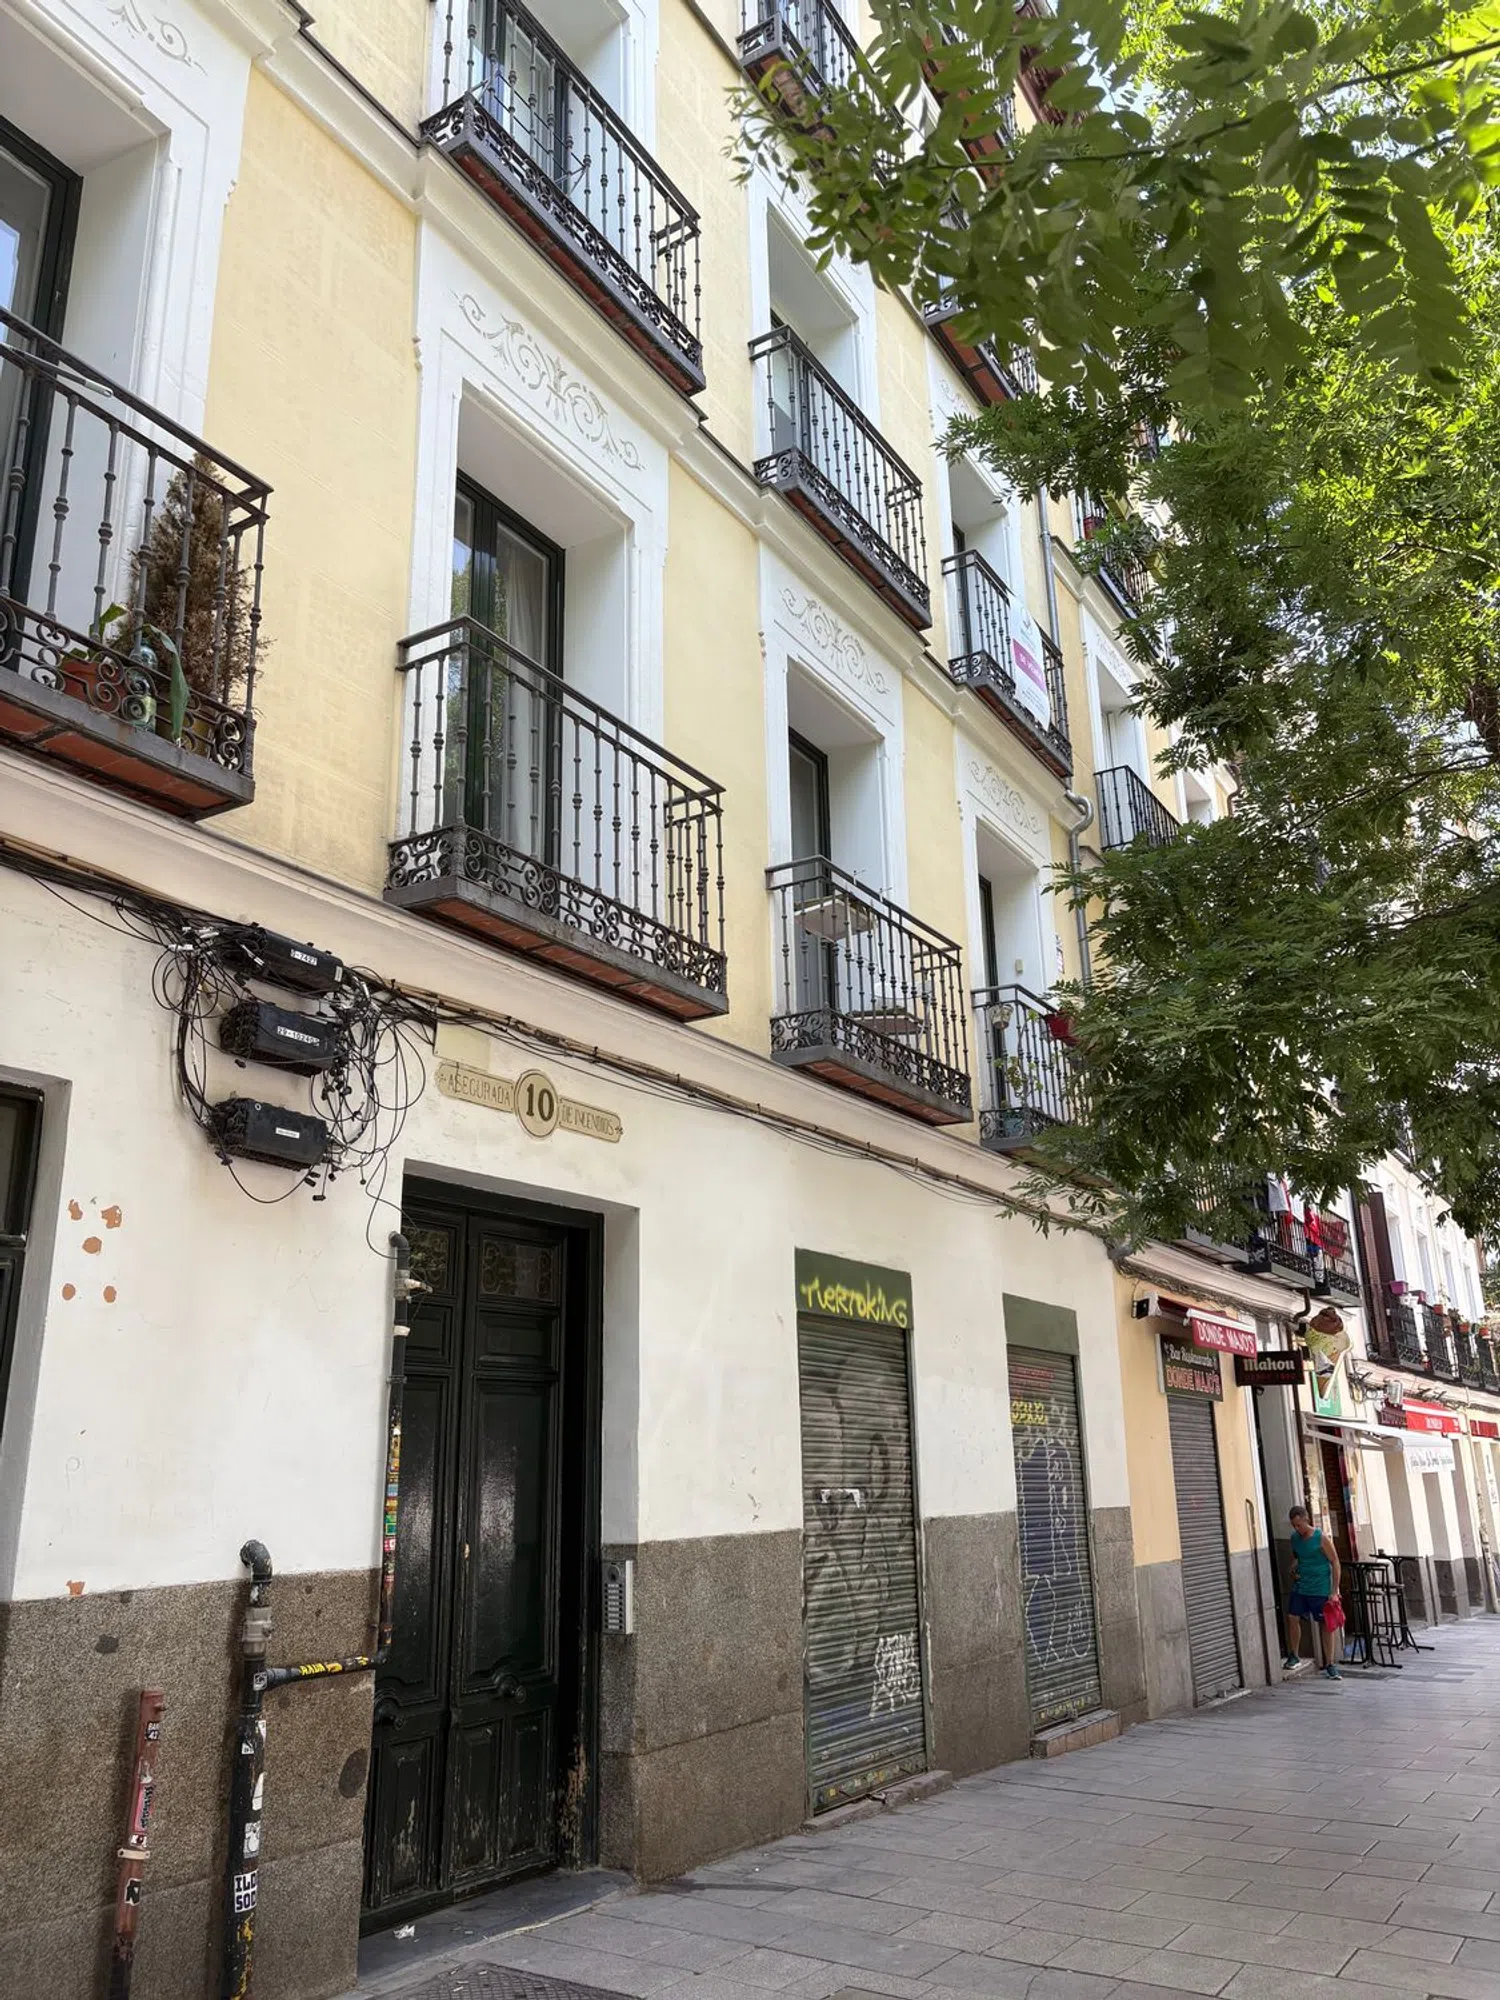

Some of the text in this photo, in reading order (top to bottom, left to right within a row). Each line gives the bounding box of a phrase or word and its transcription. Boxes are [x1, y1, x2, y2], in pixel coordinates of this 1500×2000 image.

[449, 1073, 511, 1107] ASEGURADA
[525, 1083, 555, 1122] 10
[561, 1104, 572, 1124] DE
